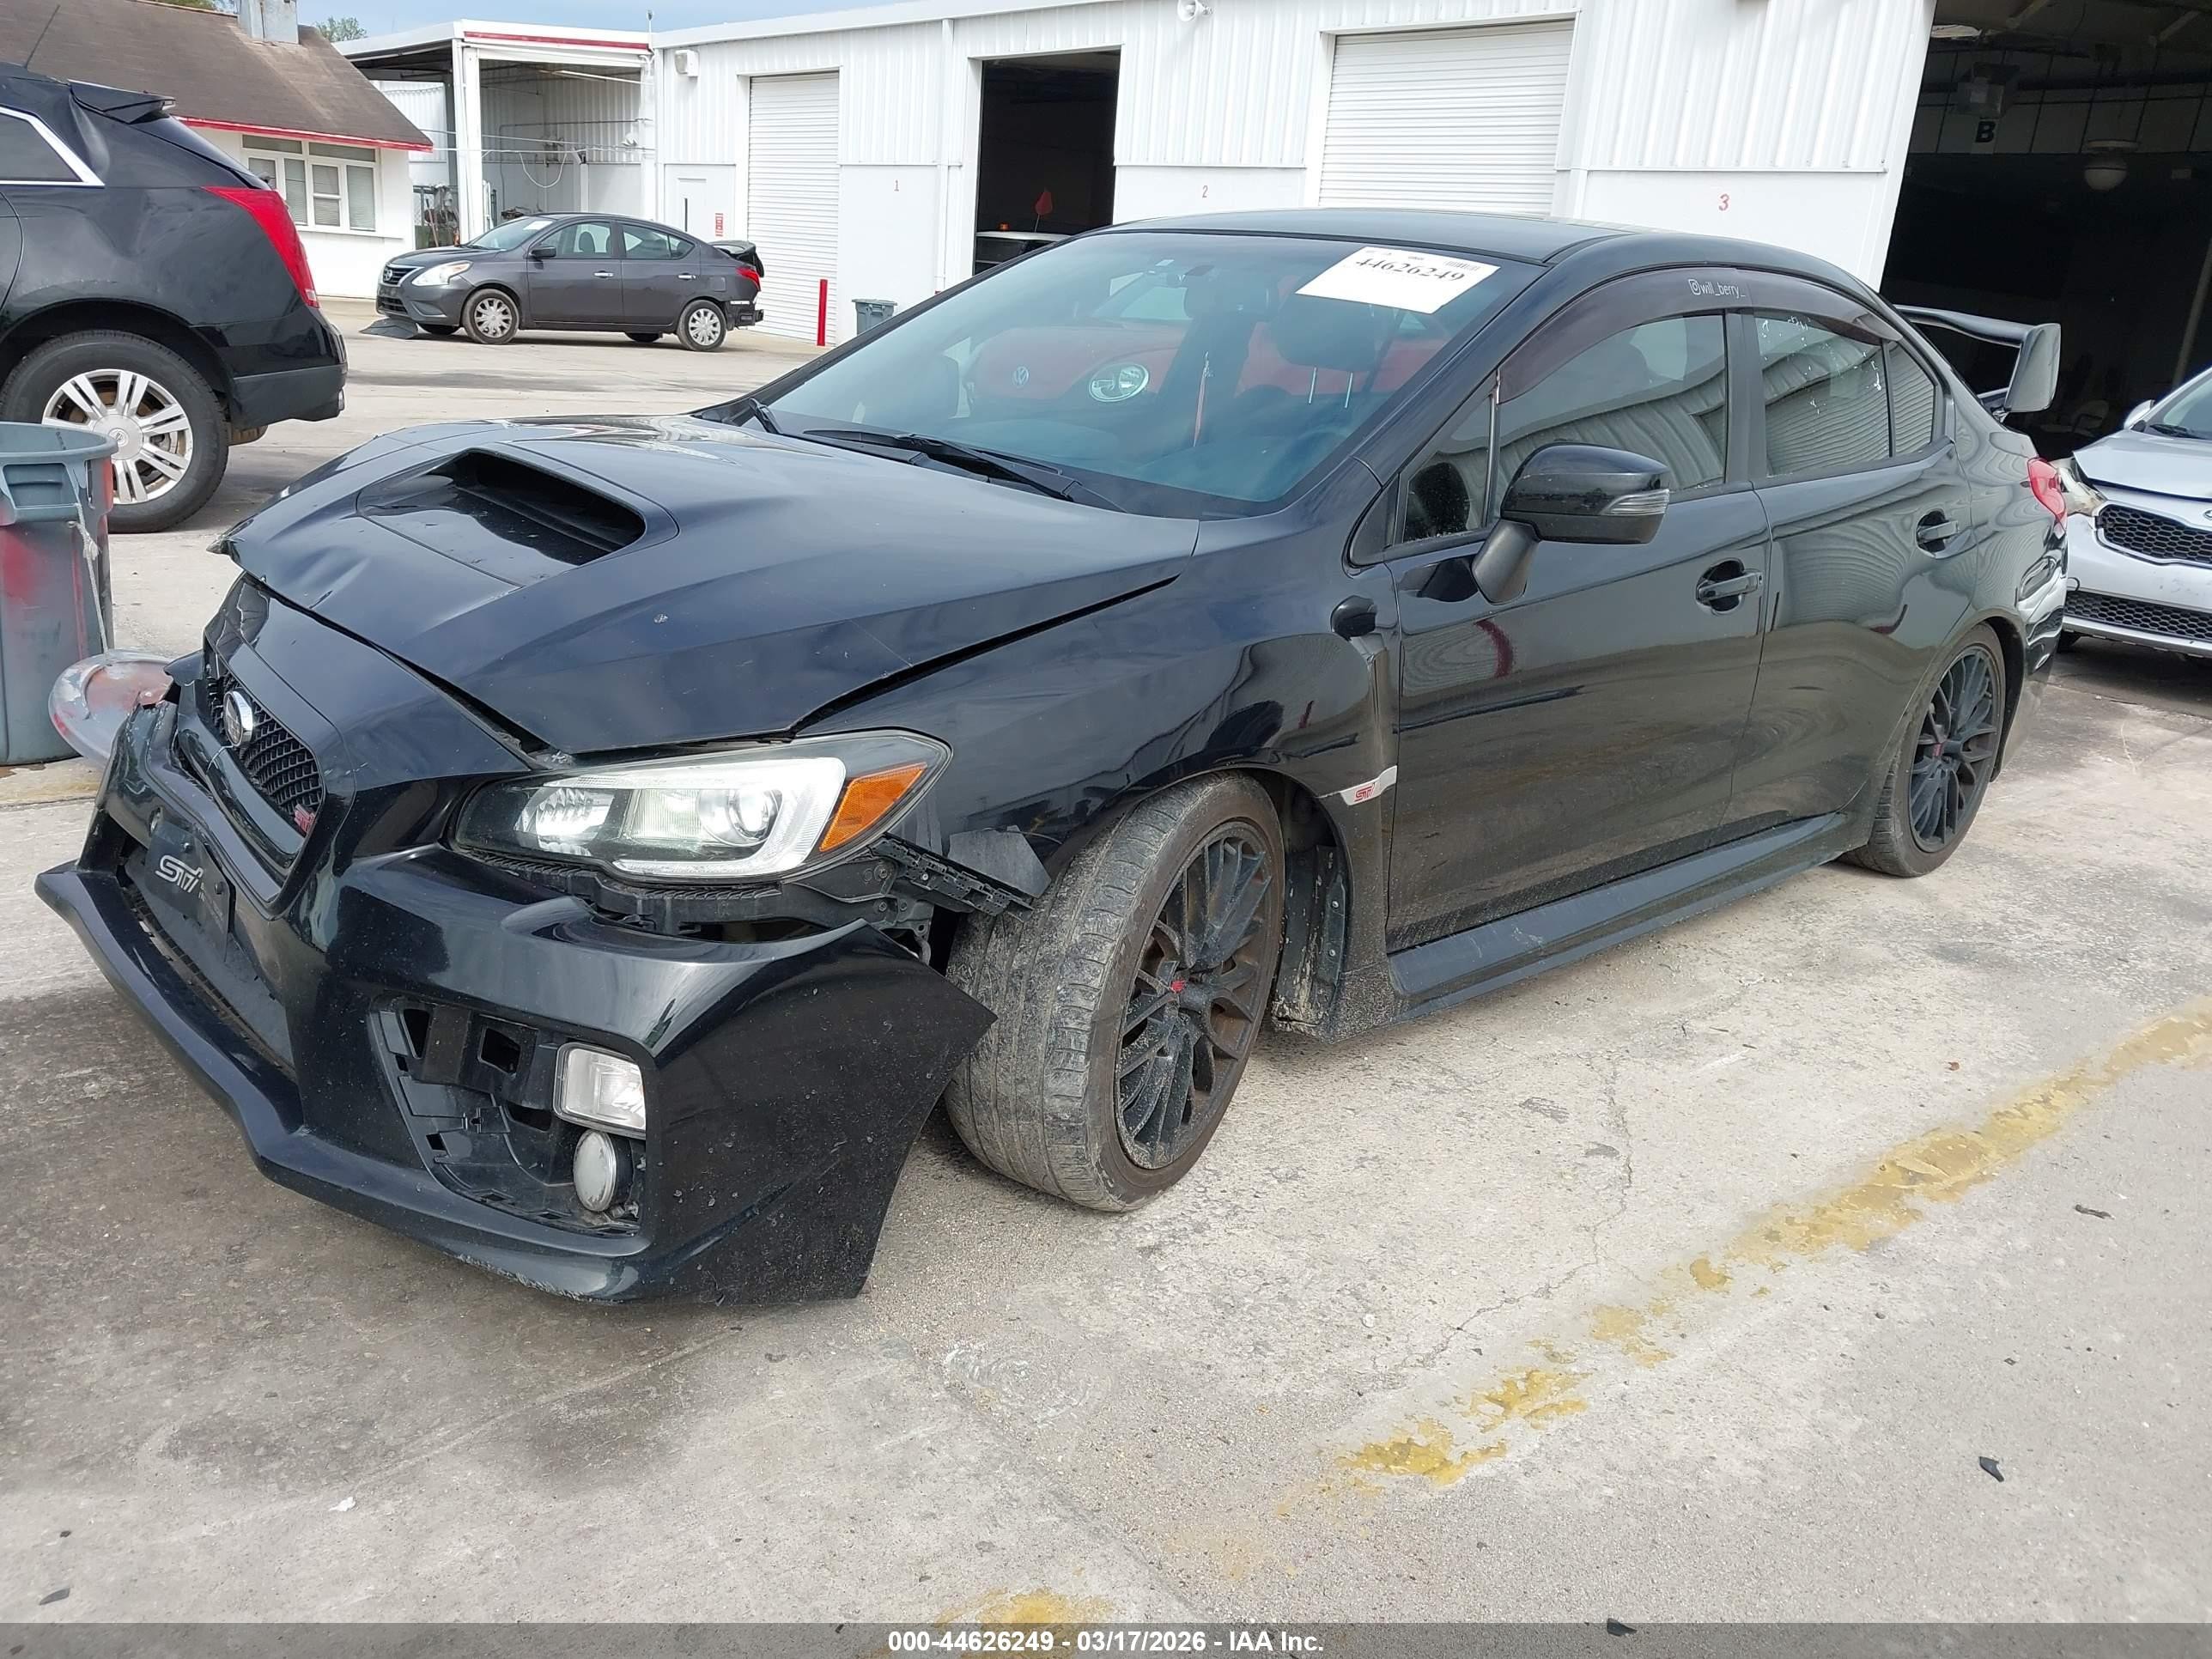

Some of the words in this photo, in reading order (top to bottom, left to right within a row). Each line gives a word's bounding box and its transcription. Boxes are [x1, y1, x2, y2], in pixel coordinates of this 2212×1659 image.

[1975, 121, 1996, 143] B
[893, 179, 900, 192] 1
[1201, 185, 1209, 198] 2
[1718, 192, 1730, 211] 3
[1355, 258, 1466, 282] 44626249
